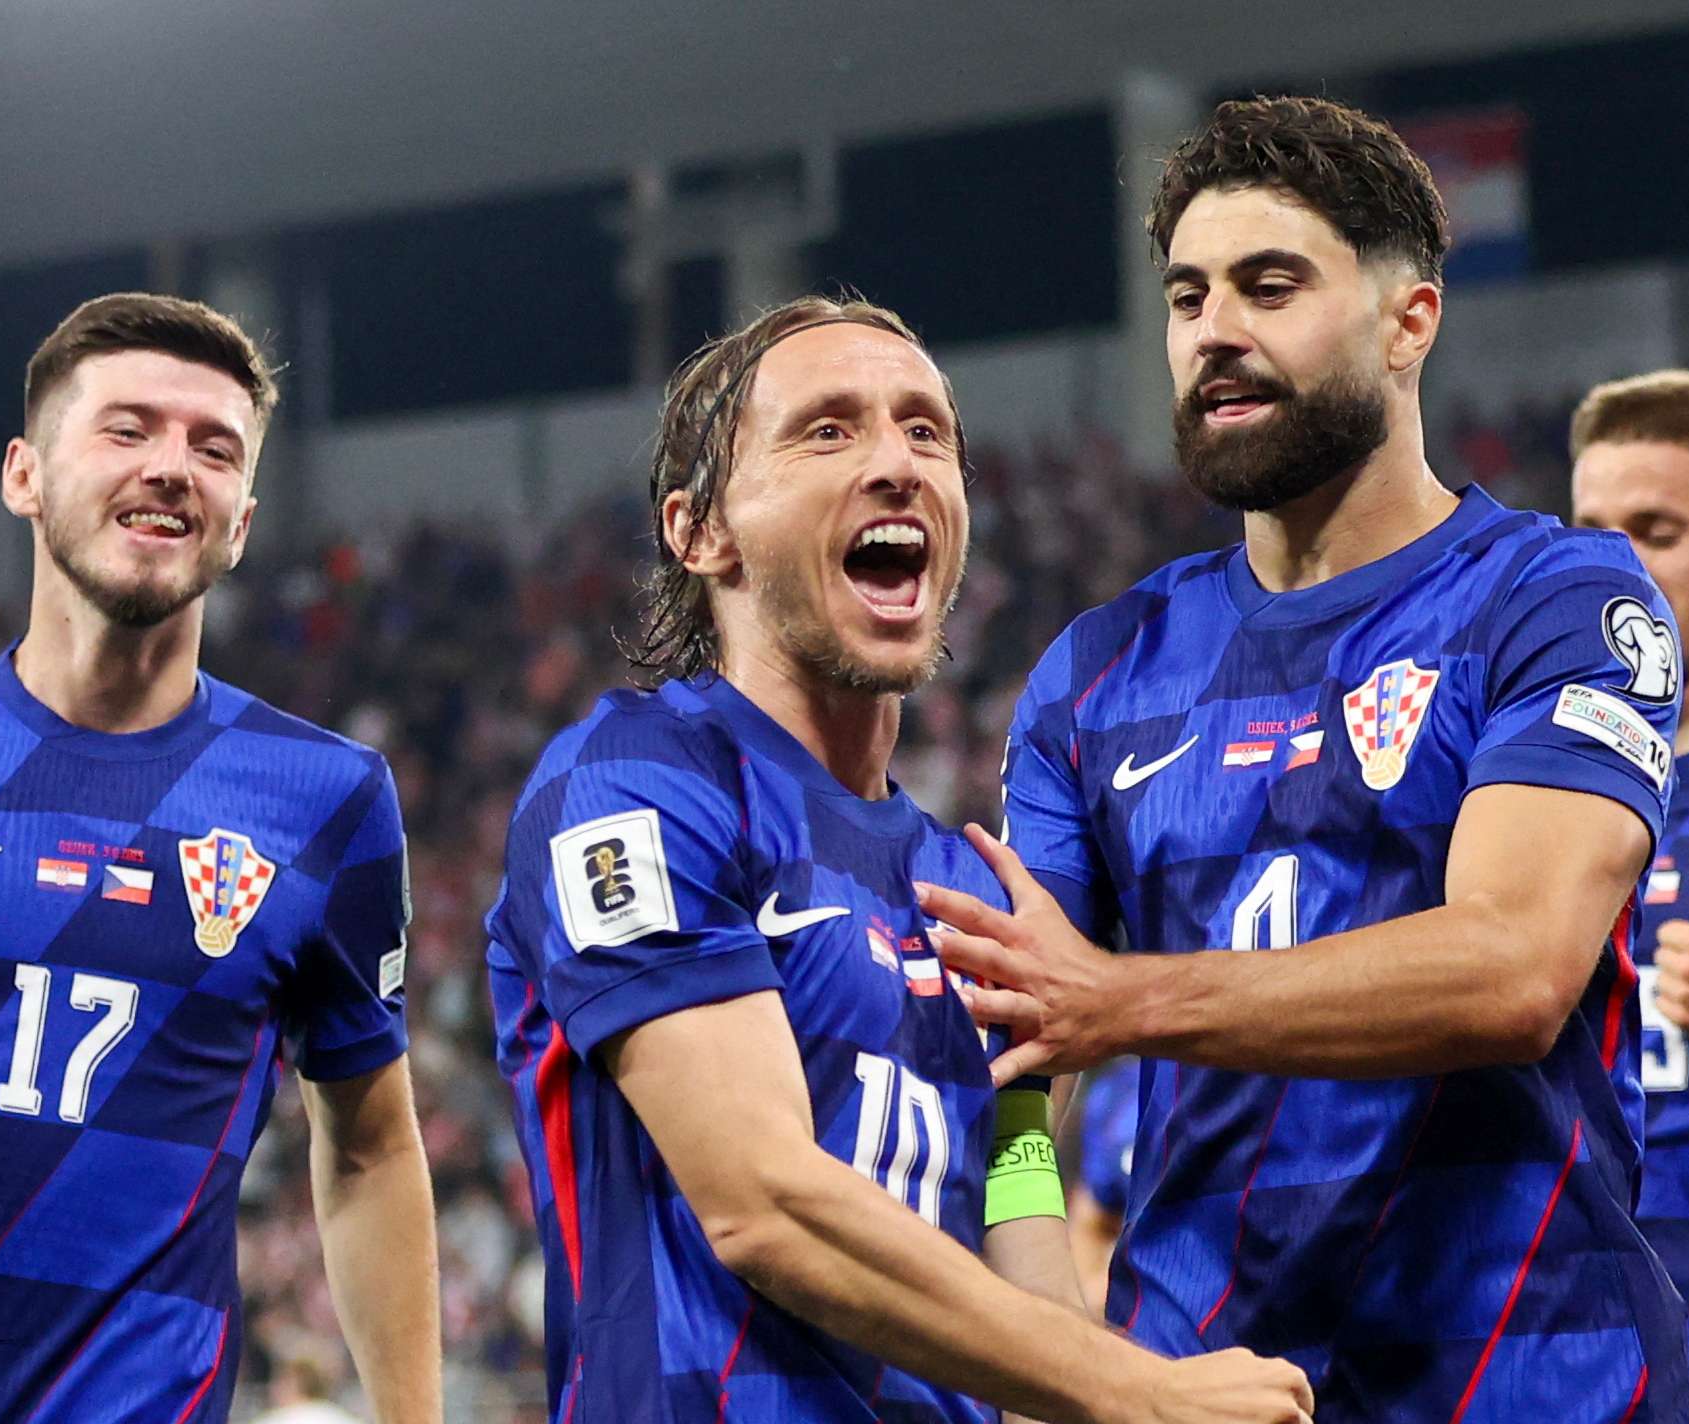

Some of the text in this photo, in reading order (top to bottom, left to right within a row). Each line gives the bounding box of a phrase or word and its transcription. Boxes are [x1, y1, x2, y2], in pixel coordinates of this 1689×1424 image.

[1567, 687, 1593, 699] UEFA
[1561, 699, 1649, 751] FOUNDATION
[853, 1052, 948, 1228] 10
[992, 1141, 1055, 1168] ESPEC
